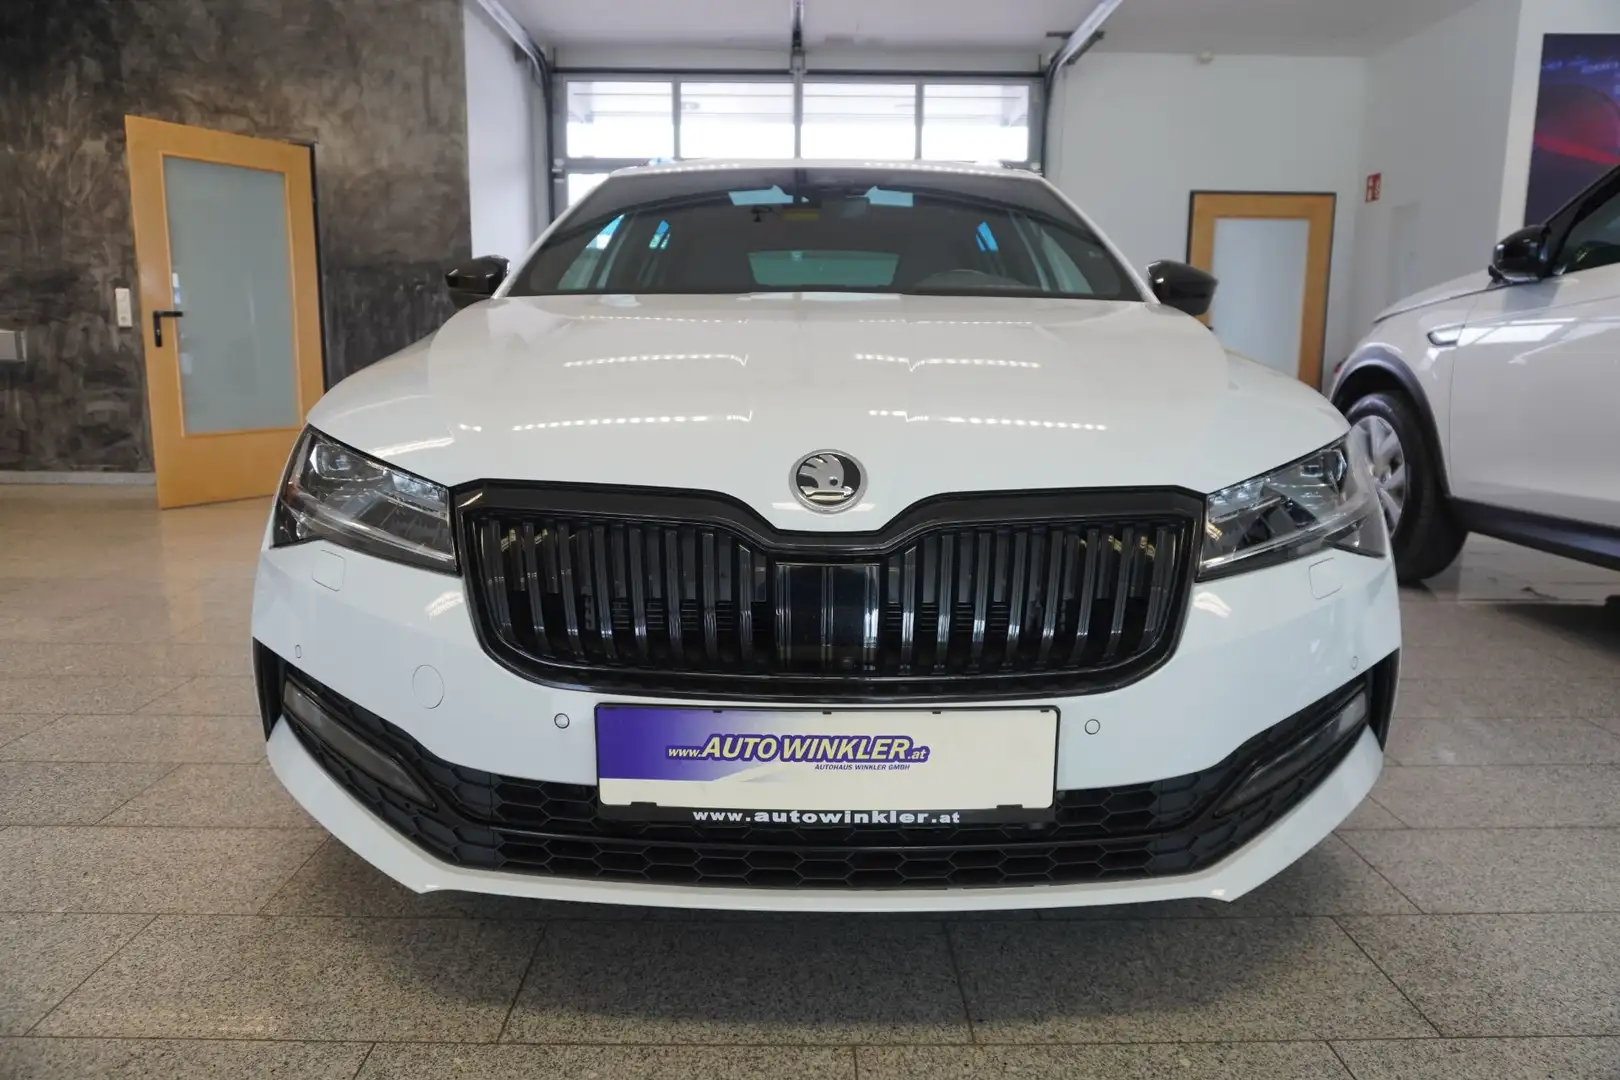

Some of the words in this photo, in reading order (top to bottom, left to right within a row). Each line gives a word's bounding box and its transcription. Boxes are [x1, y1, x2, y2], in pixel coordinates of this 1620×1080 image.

[814, 763, 853, 771] AUTOHAUS
[854, 763, 887, 771] WINKLER
[693, 810, 961, 824] www.autowinkler.at
